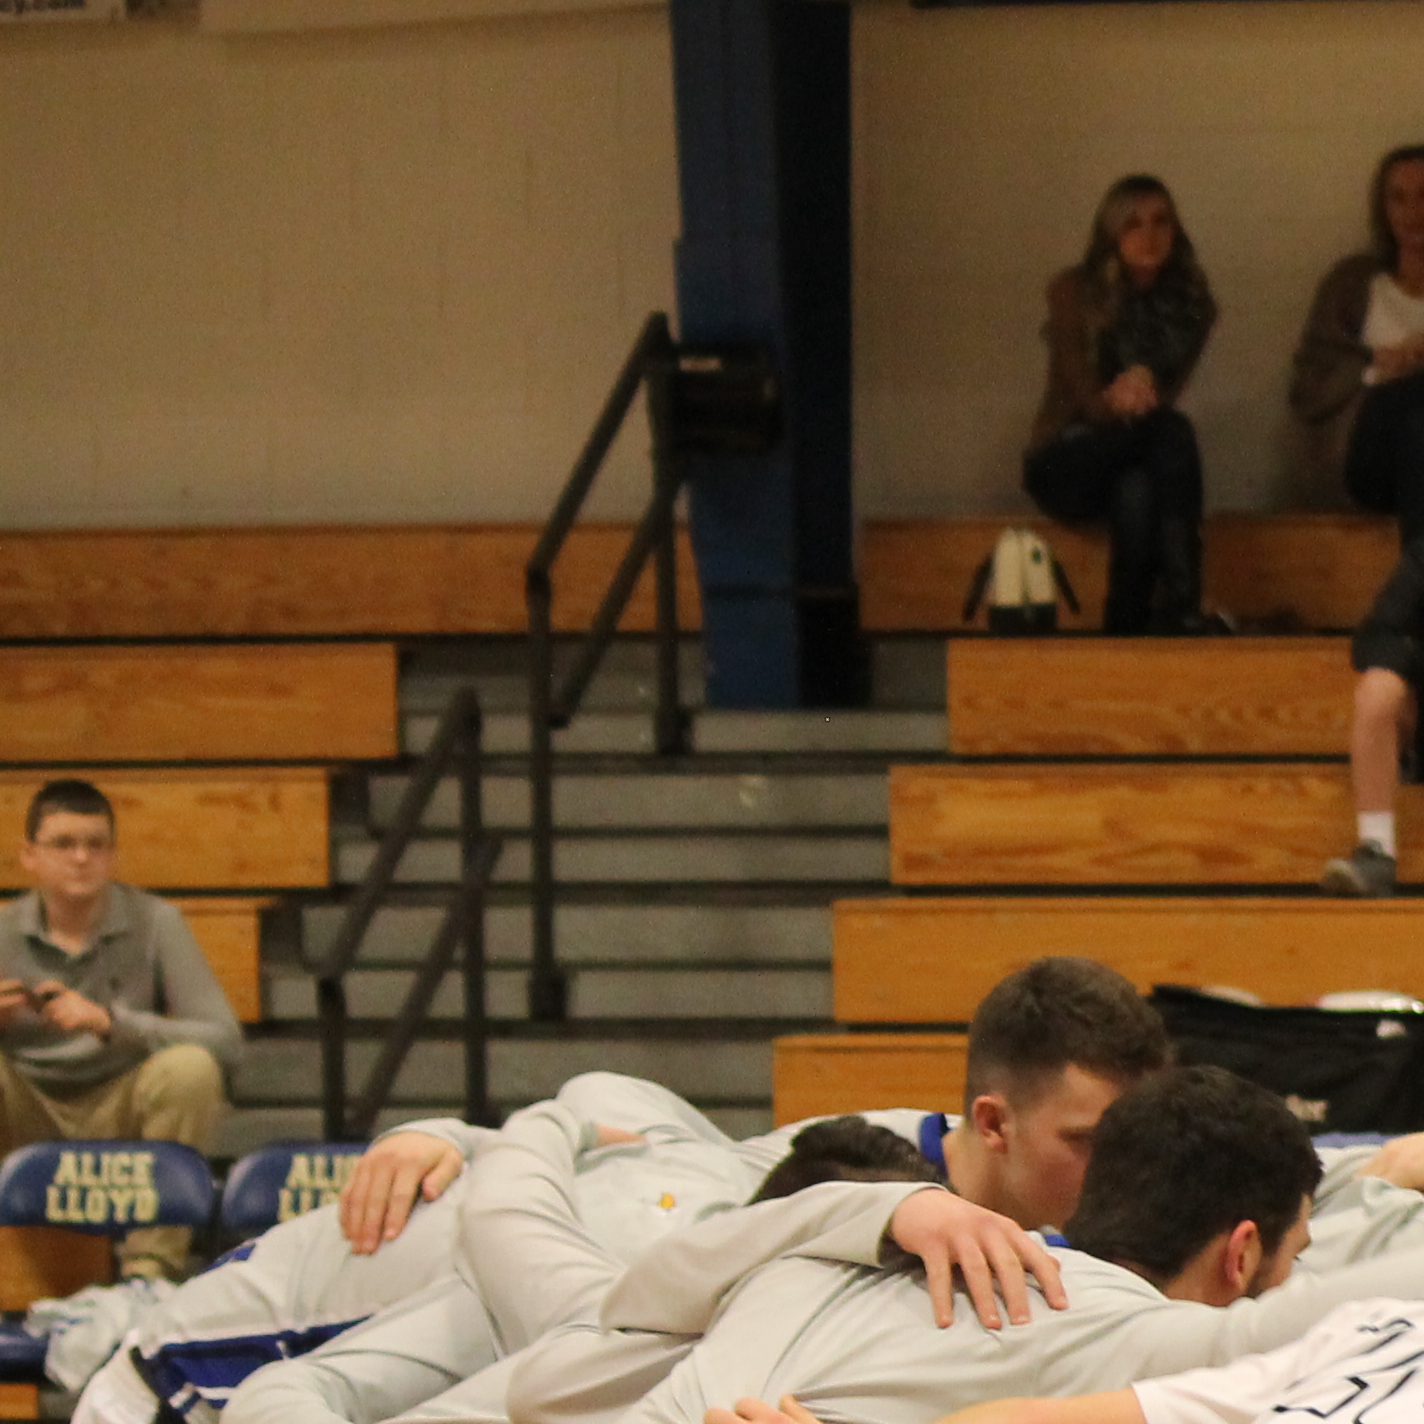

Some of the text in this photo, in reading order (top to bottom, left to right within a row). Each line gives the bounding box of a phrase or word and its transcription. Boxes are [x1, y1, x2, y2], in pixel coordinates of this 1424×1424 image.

[53, 1151, 155, 1186] ALICE
[285, 1153, 362, 1187] ALI
[46, 1186, 159, 1223] LLOYD
